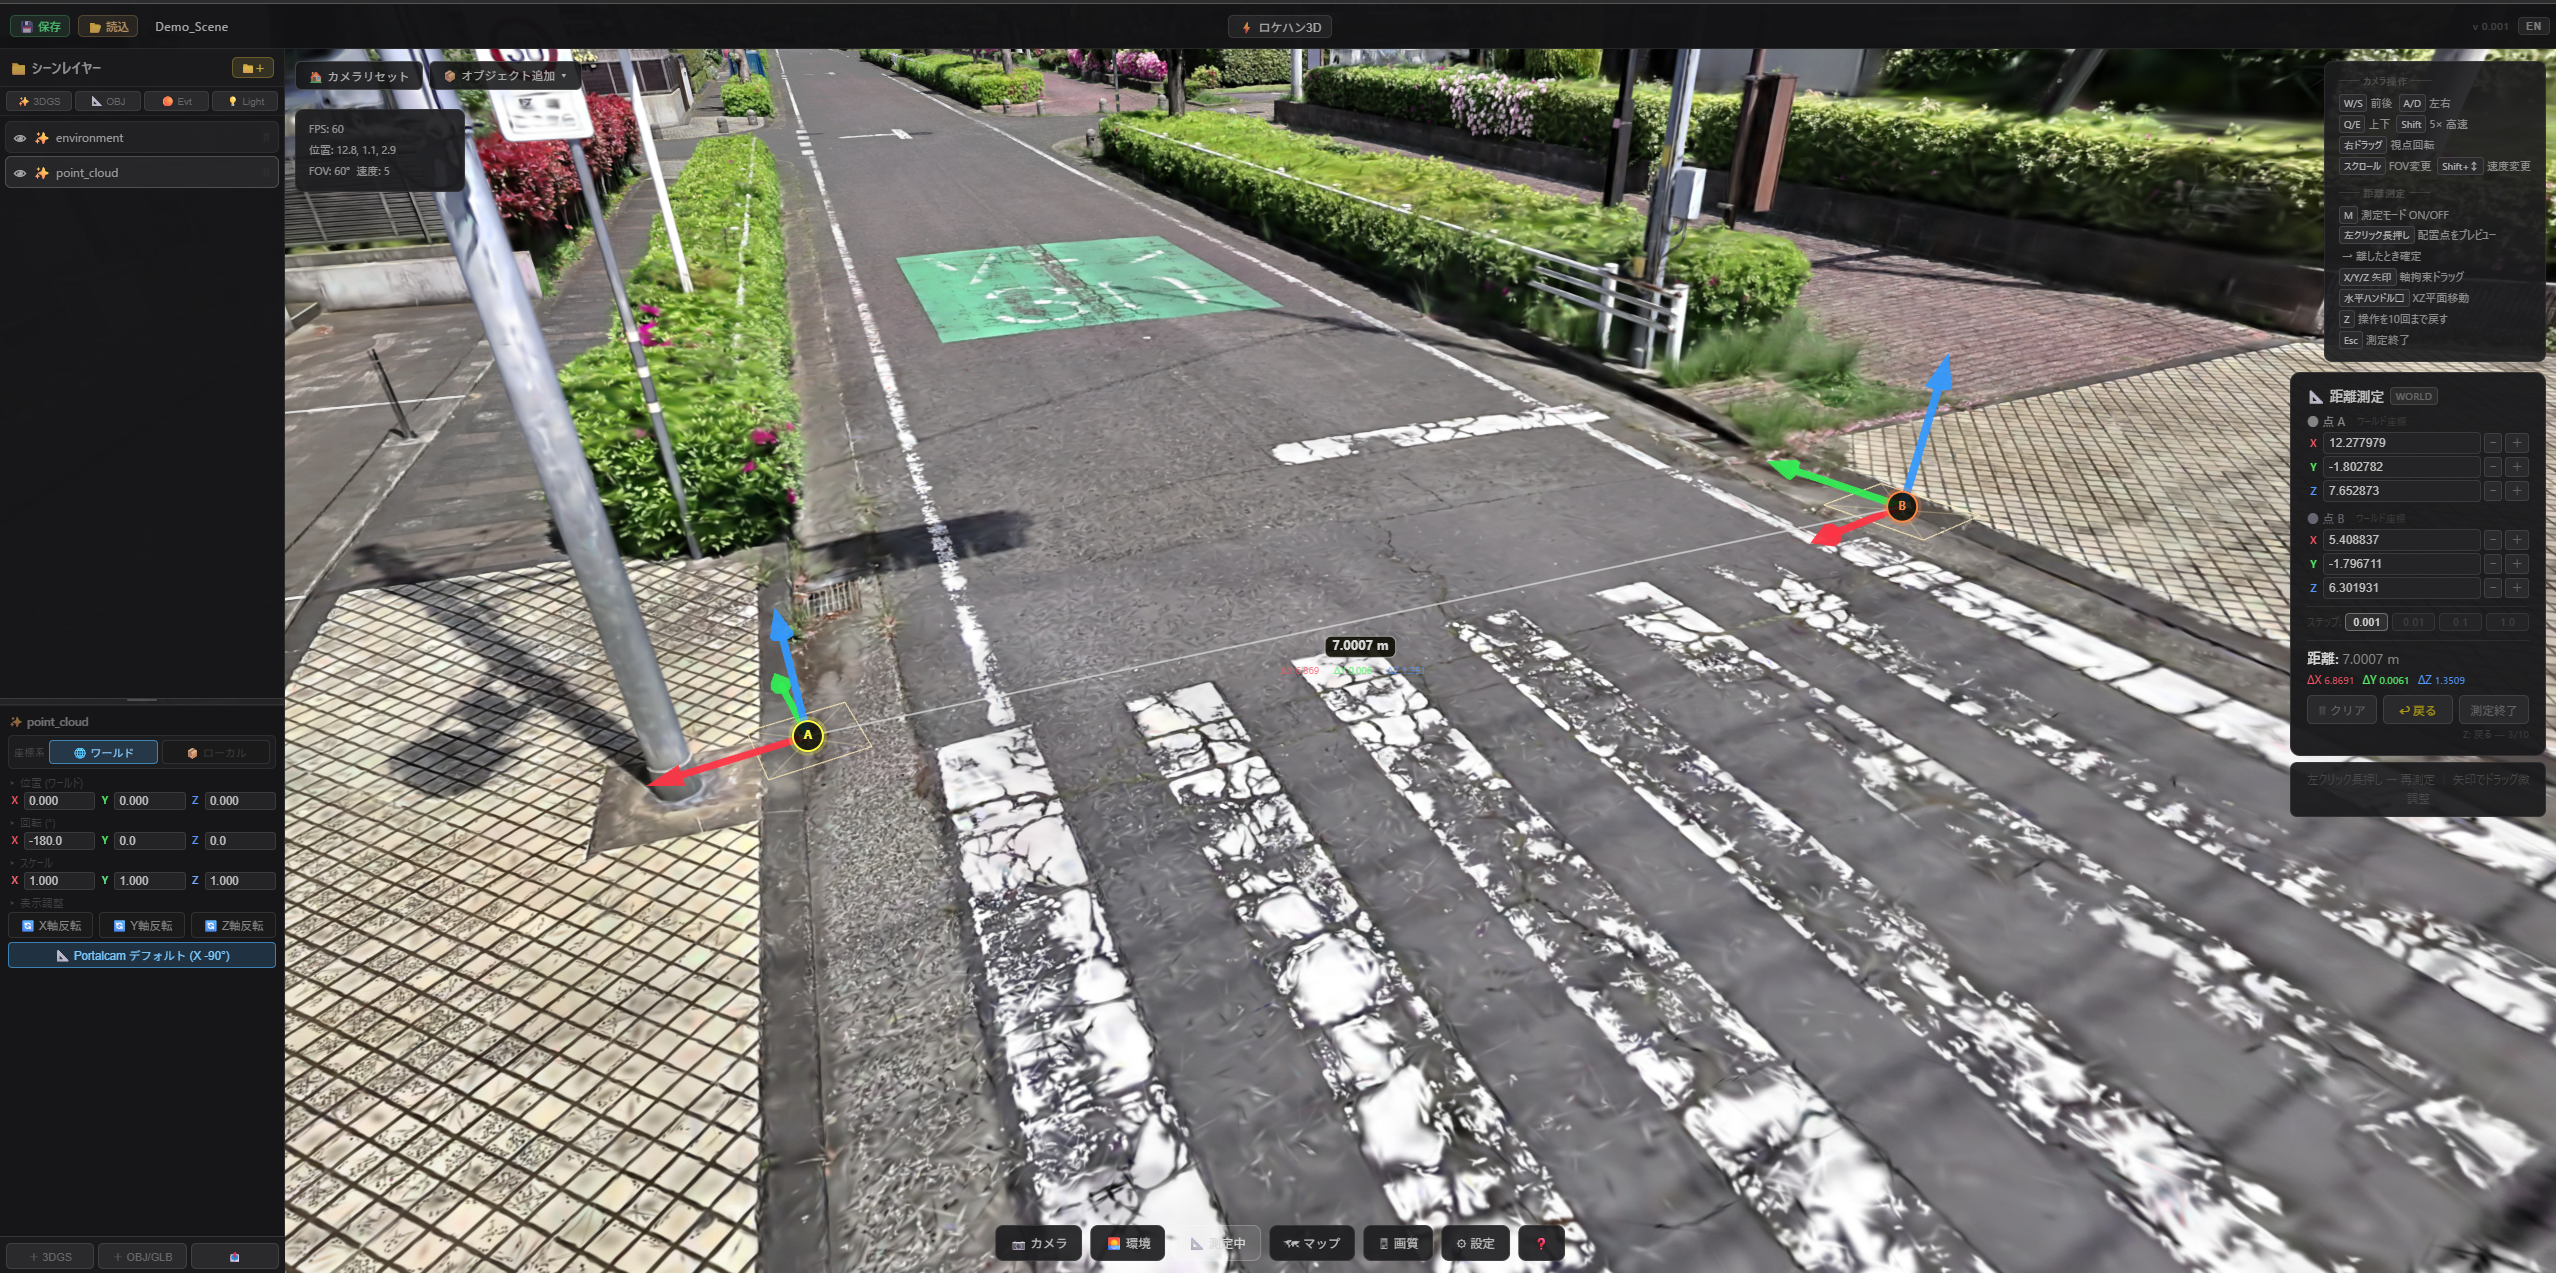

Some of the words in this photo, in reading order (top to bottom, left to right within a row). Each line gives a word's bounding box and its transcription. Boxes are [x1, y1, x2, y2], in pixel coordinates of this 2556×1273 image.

[38, 21, 61, 32] 保存
[106, 21, 129, 32] 読込
[156, 22, 228, 33] Demo_Scene
[1260, 22, 1321, 33] ロケハン3D
[2526, 22, 2541, 30] EN
[32, 62, 101, 74] シーンレイヤー
[329, 72, 408, 82] カメラリセット
[462, 70, 555, 81] オブジェクト追加
[2363, 77, 2407, 86] カメラ操作
[243, 98, 264, 107] Light
[2344, 100, 2363, 108] W/S
[2371, 98, 2392, 108] 前後
[2403, 100, 2421, 108] A/D
[2429, 98, 2451, 108] 左右
[309, 125, 329, 133] FPS:
[332, 125, 344, 133] 60
[2344, 121, 2360, 129] Q/E
[2369, 119, 2390, 129] 上下
[2446, 119, 2468, 129] 高速
[56, 133, 124, 142] environment
[2344, 140, 2383, 150] 右ドラッグ
[2391, 140, 2435, 150] 視点回転
[309, 145, 333, 155] 位置:
[337, 146, 359, 156] 12.8,
[363, 146, 378, 156] 1.1,
[381, 146, 396, 154] 2.9
[310, 167, 331, 175] FOV:
[335, 167, 350, 175] 60°
[356, 166, 381, 176] 速度:
[384, 167, 389, 175] 5
[2344, 162, 2381, 170] スクロール
[2390, 161, 2431, 171] FOV変更
[2487, 161, 2531, 171] 速度変更
[57, 168, 118, 180] point_cloud
[2364, 189, 2405, 198] 距離測定
[2361, 209, 2406, 220] 測定モード
[2409, 211, 2449, 220] ON/OFF
[2344, 231, 2409, 240] 左クリック長押し
[2418, 229, 2496, 240] 配置点をプレビュー
[2356, 251, 2421, 261] 離したとき確定
[2344, 274, 2369, 282] X/Y/Z
[2372, 273, 2391, 282] 矢印
[2400, 271, 2464, 282] 軸拘束ドラッグ
[2413, 293, 2469, 303] XZ平面移動
[2358, 314, 2448, 324] 操作を10回まで戻す
[2366, 335, 2409, 345] 測定終了
[2330, 389, 2384, 403] 距離測定
[2323, 416, 2334, 427] 点
[2337, 417, 2345, 426] A
[2358, 416, 2406, 426] ワールド座標
[2310, 439, 2317, 447] X
[2330, 438, 2386, 447] 12.277979
[2310, 463, 2317, 471] Y
[2329, 462, 2383, 471] -1.802782
[2310, 487, 2317, 495] Z
[2329, 486, 2379, 495] 7.652873
[1896, 499, 1908, 512] B
[2323, 513, 2334, 524] 点
[2338, 514, 2344, 523] B
[2357, 513, 2405, 523] ワールド座標
[2310, 536, 2317, 544] X
[2329, 535, 2379, 544] 5.408837
[2310, 560, 2317, 568] Y
[2329, 559, 2381, 568] -1.796711
[2310, 584, 2317, 592] Z
[2329, 583, 2378, 592] 6.301931
[2307, 616, 2341, 627] ステップ:
[2354, 618, 2379, 626] 0.001
[2404, 618, 2423, 626] 0.01
[2454, 618, 2466, 626] 0.1
[2501, 618, 2515, 626] 1.0
[1333, 640, 1373, 650] 7.0007
[2307, 651, 2338, 665] 距離:
[2343, 654, 2383, 664] 7.0007
[2307, 675, 2321, 684] ΔX
[2362, 675, 2377, 684] ΔY
[2418, 675, 2432, 684] ΔZ
[2331, 705, 2365, 716] クリア
[2413, 706, 2435, 716] 戻る
[2471, 705, 2516, 716] 測定終了
[27, 717, 88, 729] point_cloud
[803, 730, 813, 740] A
[2474, 730, 2491, 739] 戻る
[2509, 731, 2529, 739] 3/10
[14, 748, 44, 757] 座標系
[92, 749, 133, 758] ワールド
[204, 748, 246, 757] ローカル
[20, 778, 42, 788] 位置
[45, 777, 83, 789] (ワールド)
[2308, 774, 2382, 785] 左クリック長押し
[2401, 774, 2434, 785] 再測定
[12, 796, 18, 804] X
[29, 796, 58, 805] 0.000
[102, 796, 108, 804] Y
[120, 796, 148, 805] 0.000
[192, 796, 198, 804] Z
[210, 796, 239, 805] 0.000
[2407, 793, 2429, 804] 調整
[21, 818, 42, 828] 回転
[29, 836, 62, 845] -180.0
[120, 836, 136, 845] 0.0
[210, 836, 226, 845] 0.0
[20, 858, 53, 868] スケール
[30, 876, 58, 885] 1.000
[120, 876, 148, 885] 1.000
[211, 876, 239, 885] 1.000
[20, 898, 63, 908] 表示調整
[39, 920, 81, 931] X軸反転
[130, 920, 172, 931] Y軸反転
[222, 920, 263, 931] Z軸反転
[74, 951, 126, 960] Portalcam
[130, 950, 185, 961] デフォルト
[190, 951, 201, 962] (X
[204, 951, 229, 962] -90°)
[1032, 1238, 1066, 1249] カメラ
[1126, 1237, 1151, 1249] 環境
[1209, 1237, 1246, 1250] 測定中
[1304, 1238, 1340, 1249] マップ
[1394, 1237, 1418, 1249] 画質
[1471, 1237, 1494, 1249] 設定
[43, 1253, 72, 1261] 3DGS
[127, 1253, 172, 1261] OBJ/GLB
